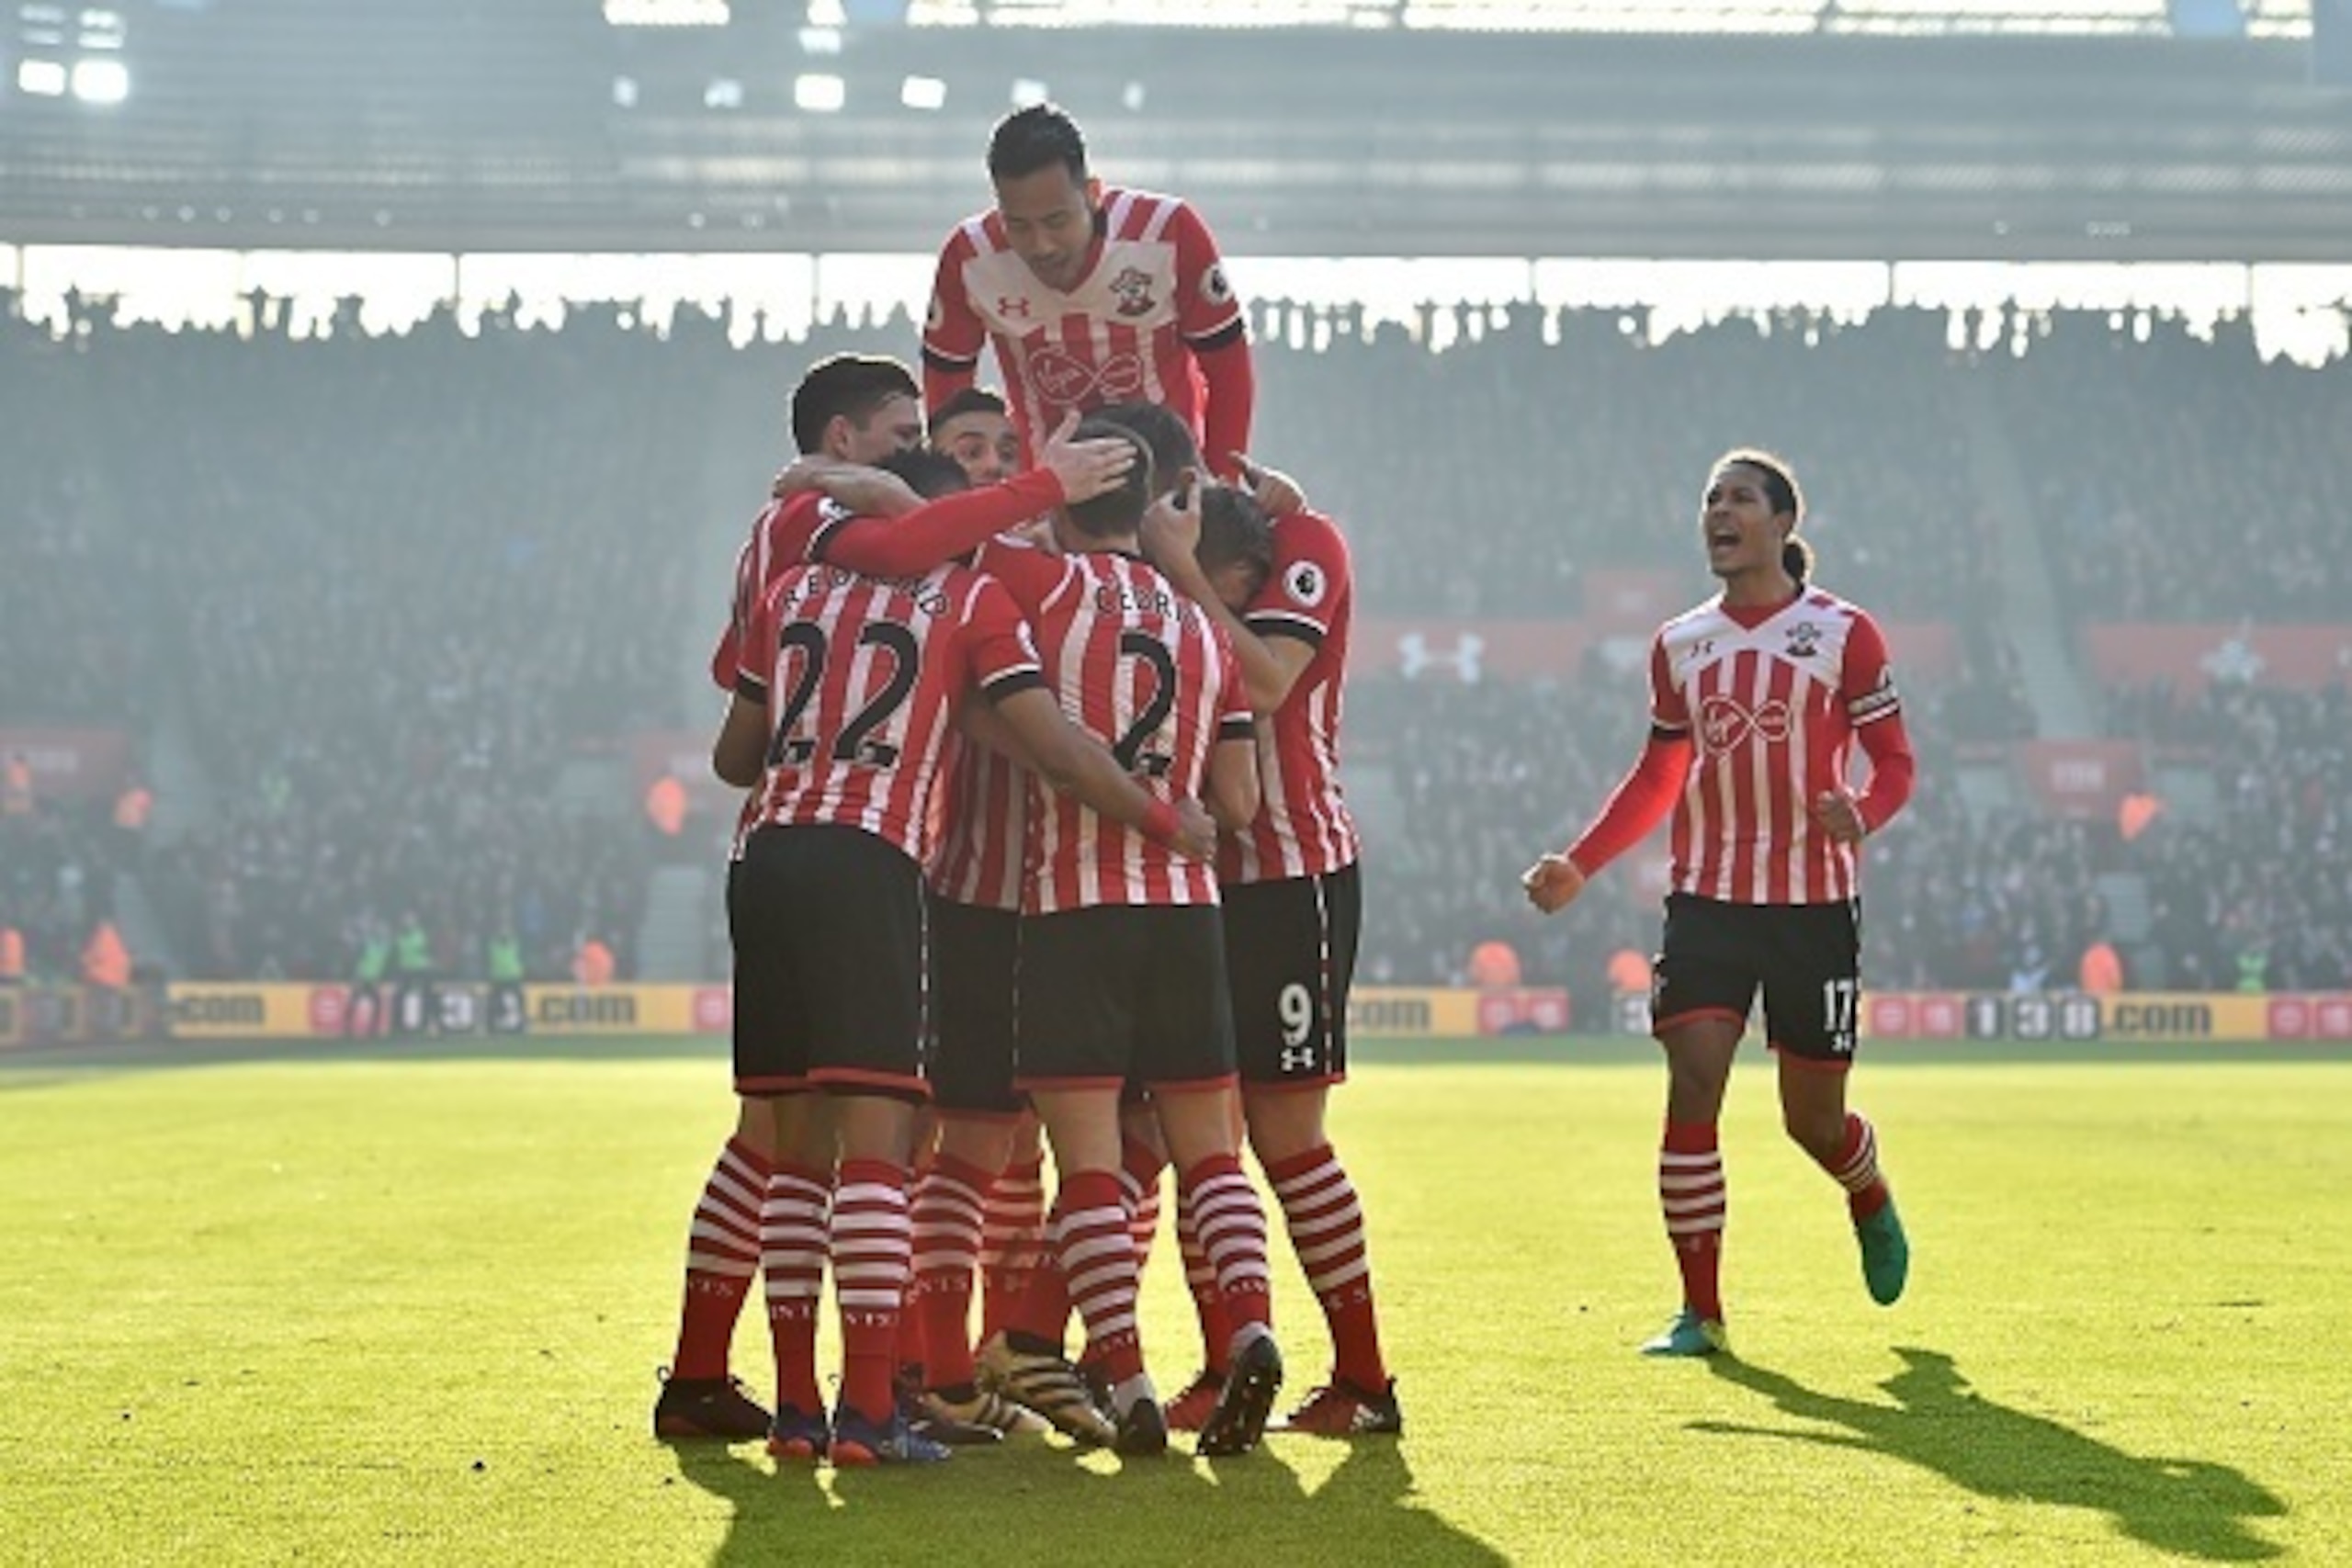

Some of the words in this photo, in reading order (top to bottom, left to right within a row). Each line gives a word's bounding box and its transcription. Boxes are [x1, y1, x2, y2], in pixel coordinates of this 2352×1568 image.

[768, 623, 918, 766] 22
[1114, 634, 1175, 775] 2
[1279, 983, 1313, 1046] 9
[1823, 979, 1854, 1032] 17
